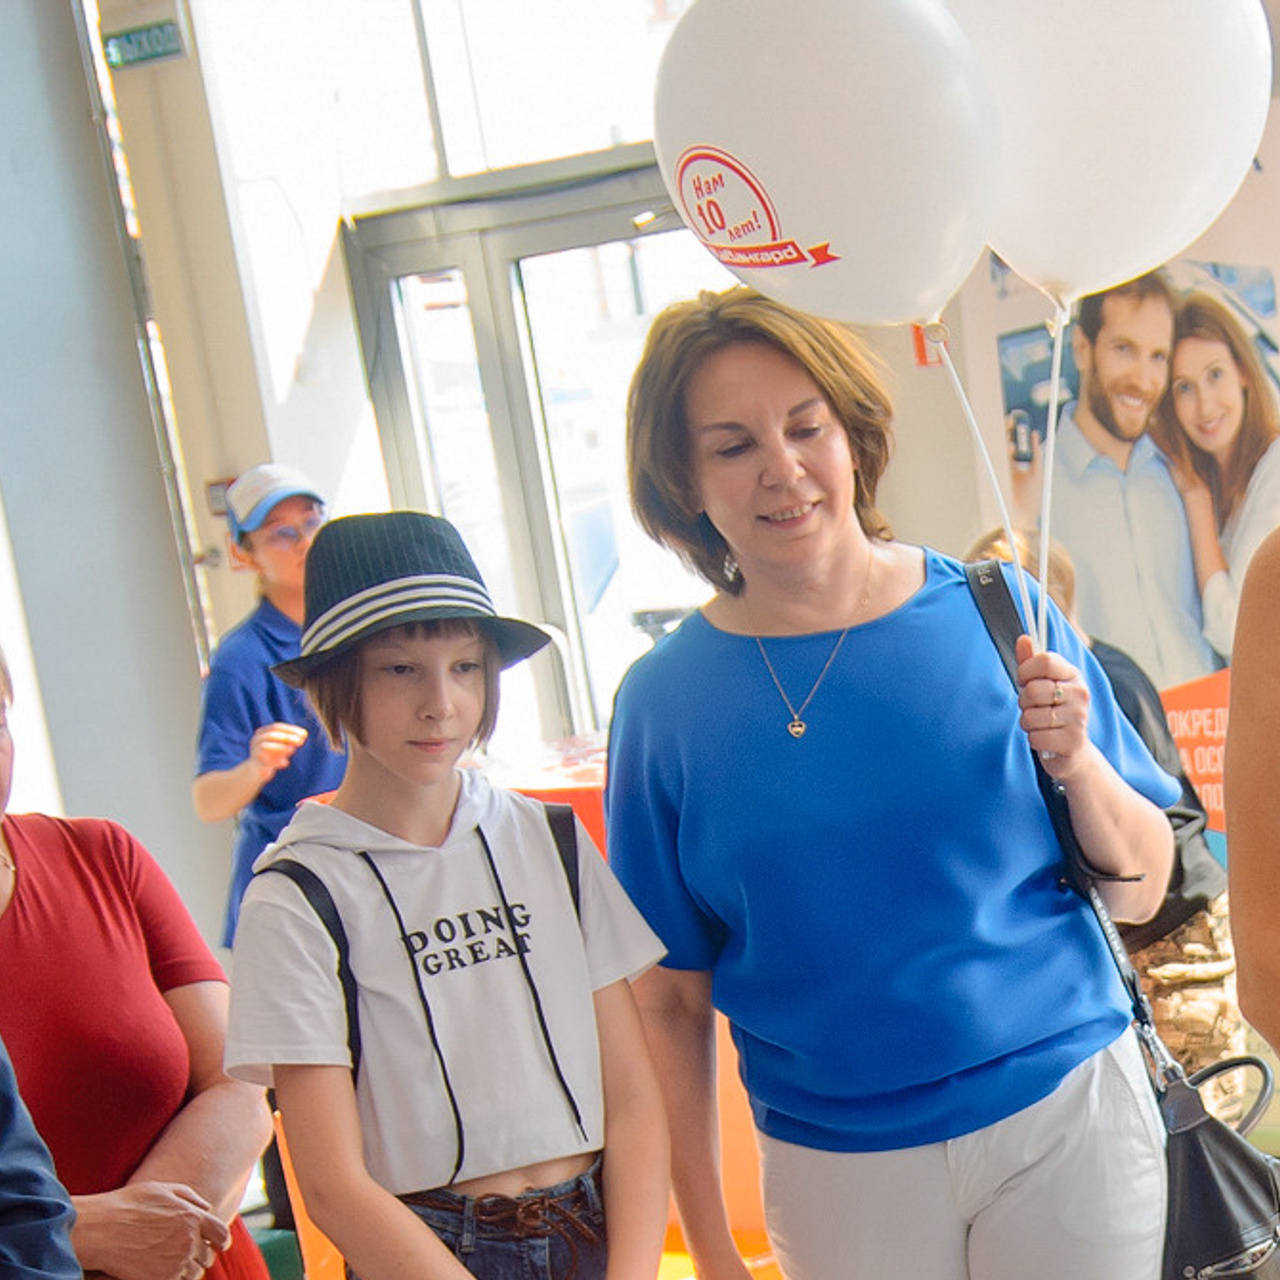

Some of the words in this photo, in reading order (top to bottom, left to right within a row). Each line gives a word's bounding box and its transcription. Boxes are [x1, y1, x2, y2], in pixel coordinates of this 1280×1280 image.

[692, 173, 725, 199] Нам
[697, 199, 726, 235] 10
[401, 903, 532, 954] DOING
[422, 932, 532, 976] GREAT
